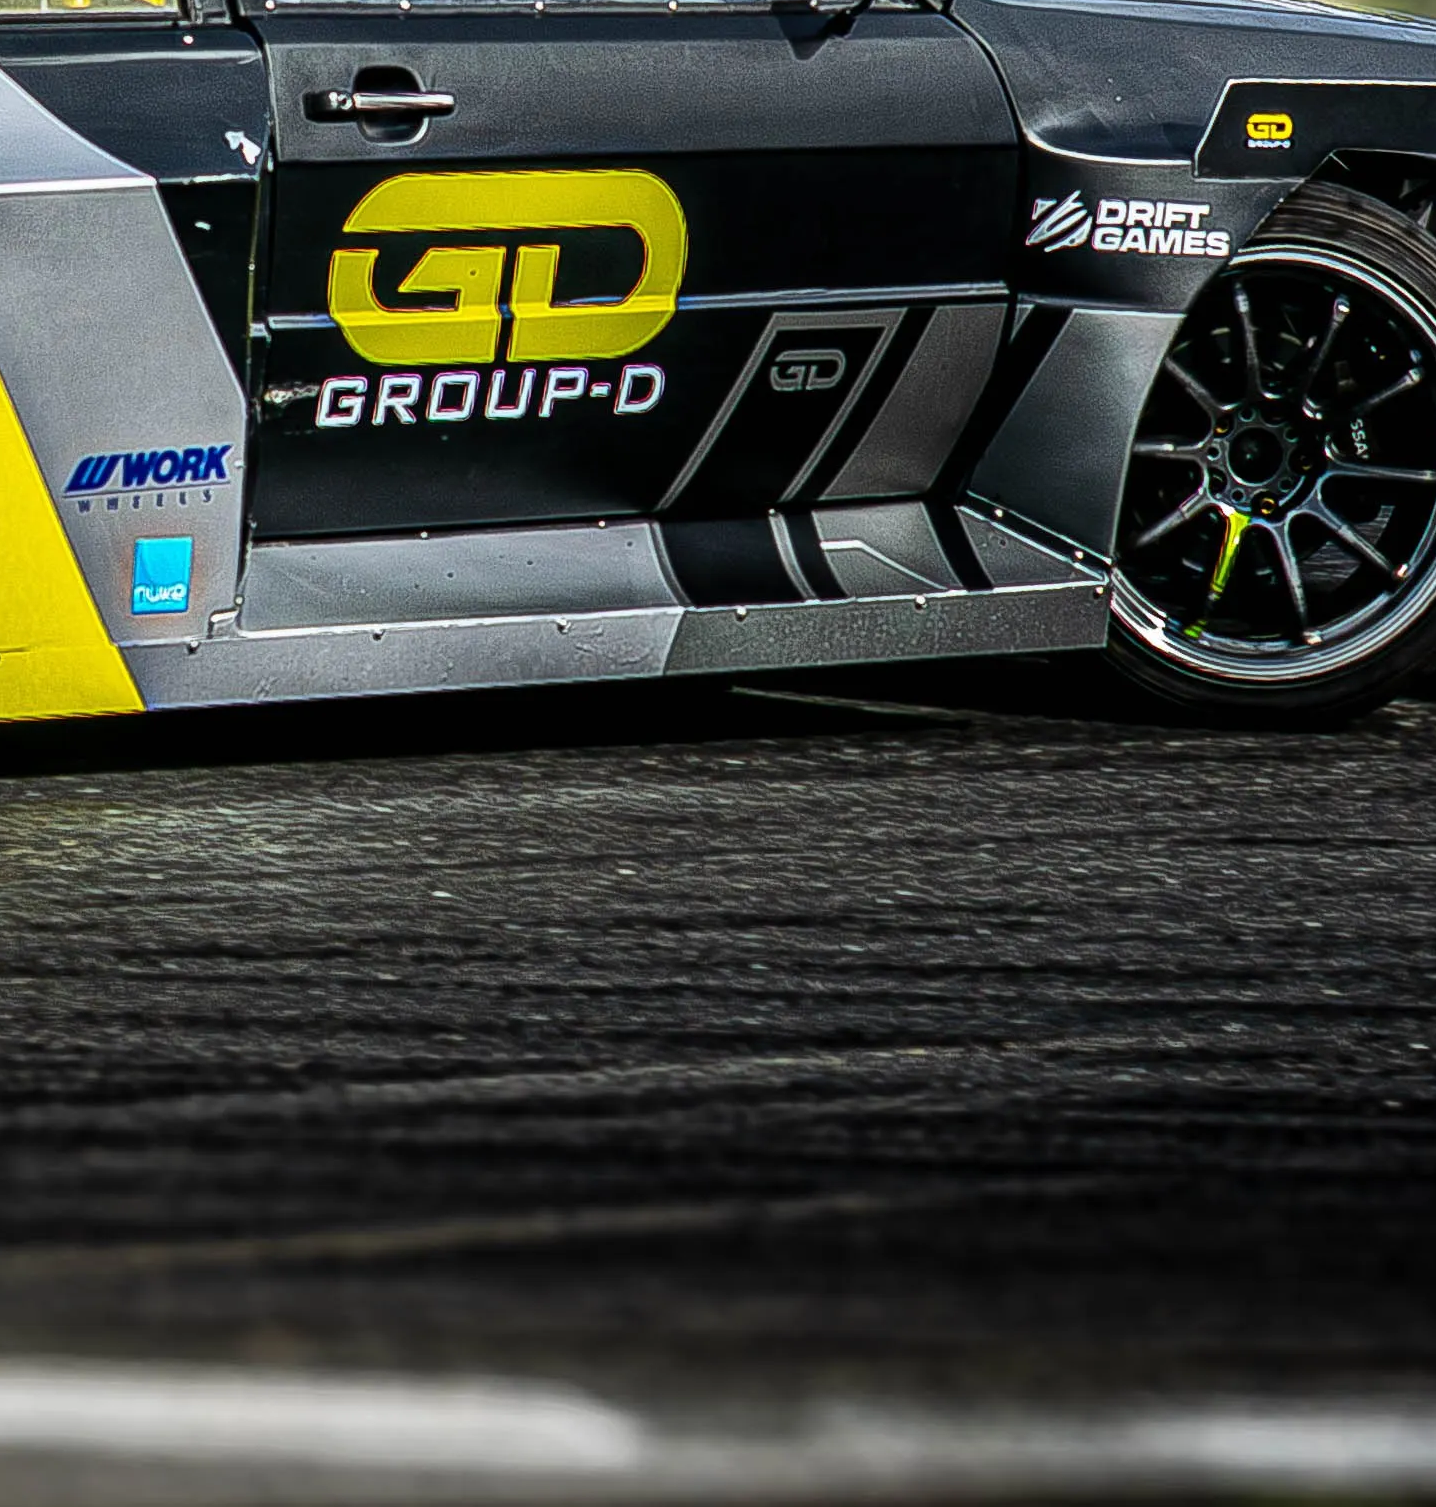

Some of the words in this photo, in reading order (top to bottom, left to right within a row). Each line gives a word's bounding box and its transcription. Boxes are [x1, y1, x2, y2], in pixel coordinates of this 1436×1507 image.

[1246, 113, 1293, 139] GD
[1096, 198, 1211, 229] DRIFT
[1092, 228, 1230, 256] GAMES
[329, 169, 689, 365] GD
[769, 349, 847, 391] GD
[315, 364, 666, 429] GROUP-D
[122, 445, 232, 487] WORK
[78, 490, 212, 513] WHEELS
[134, 584, 188, 603] nuke
